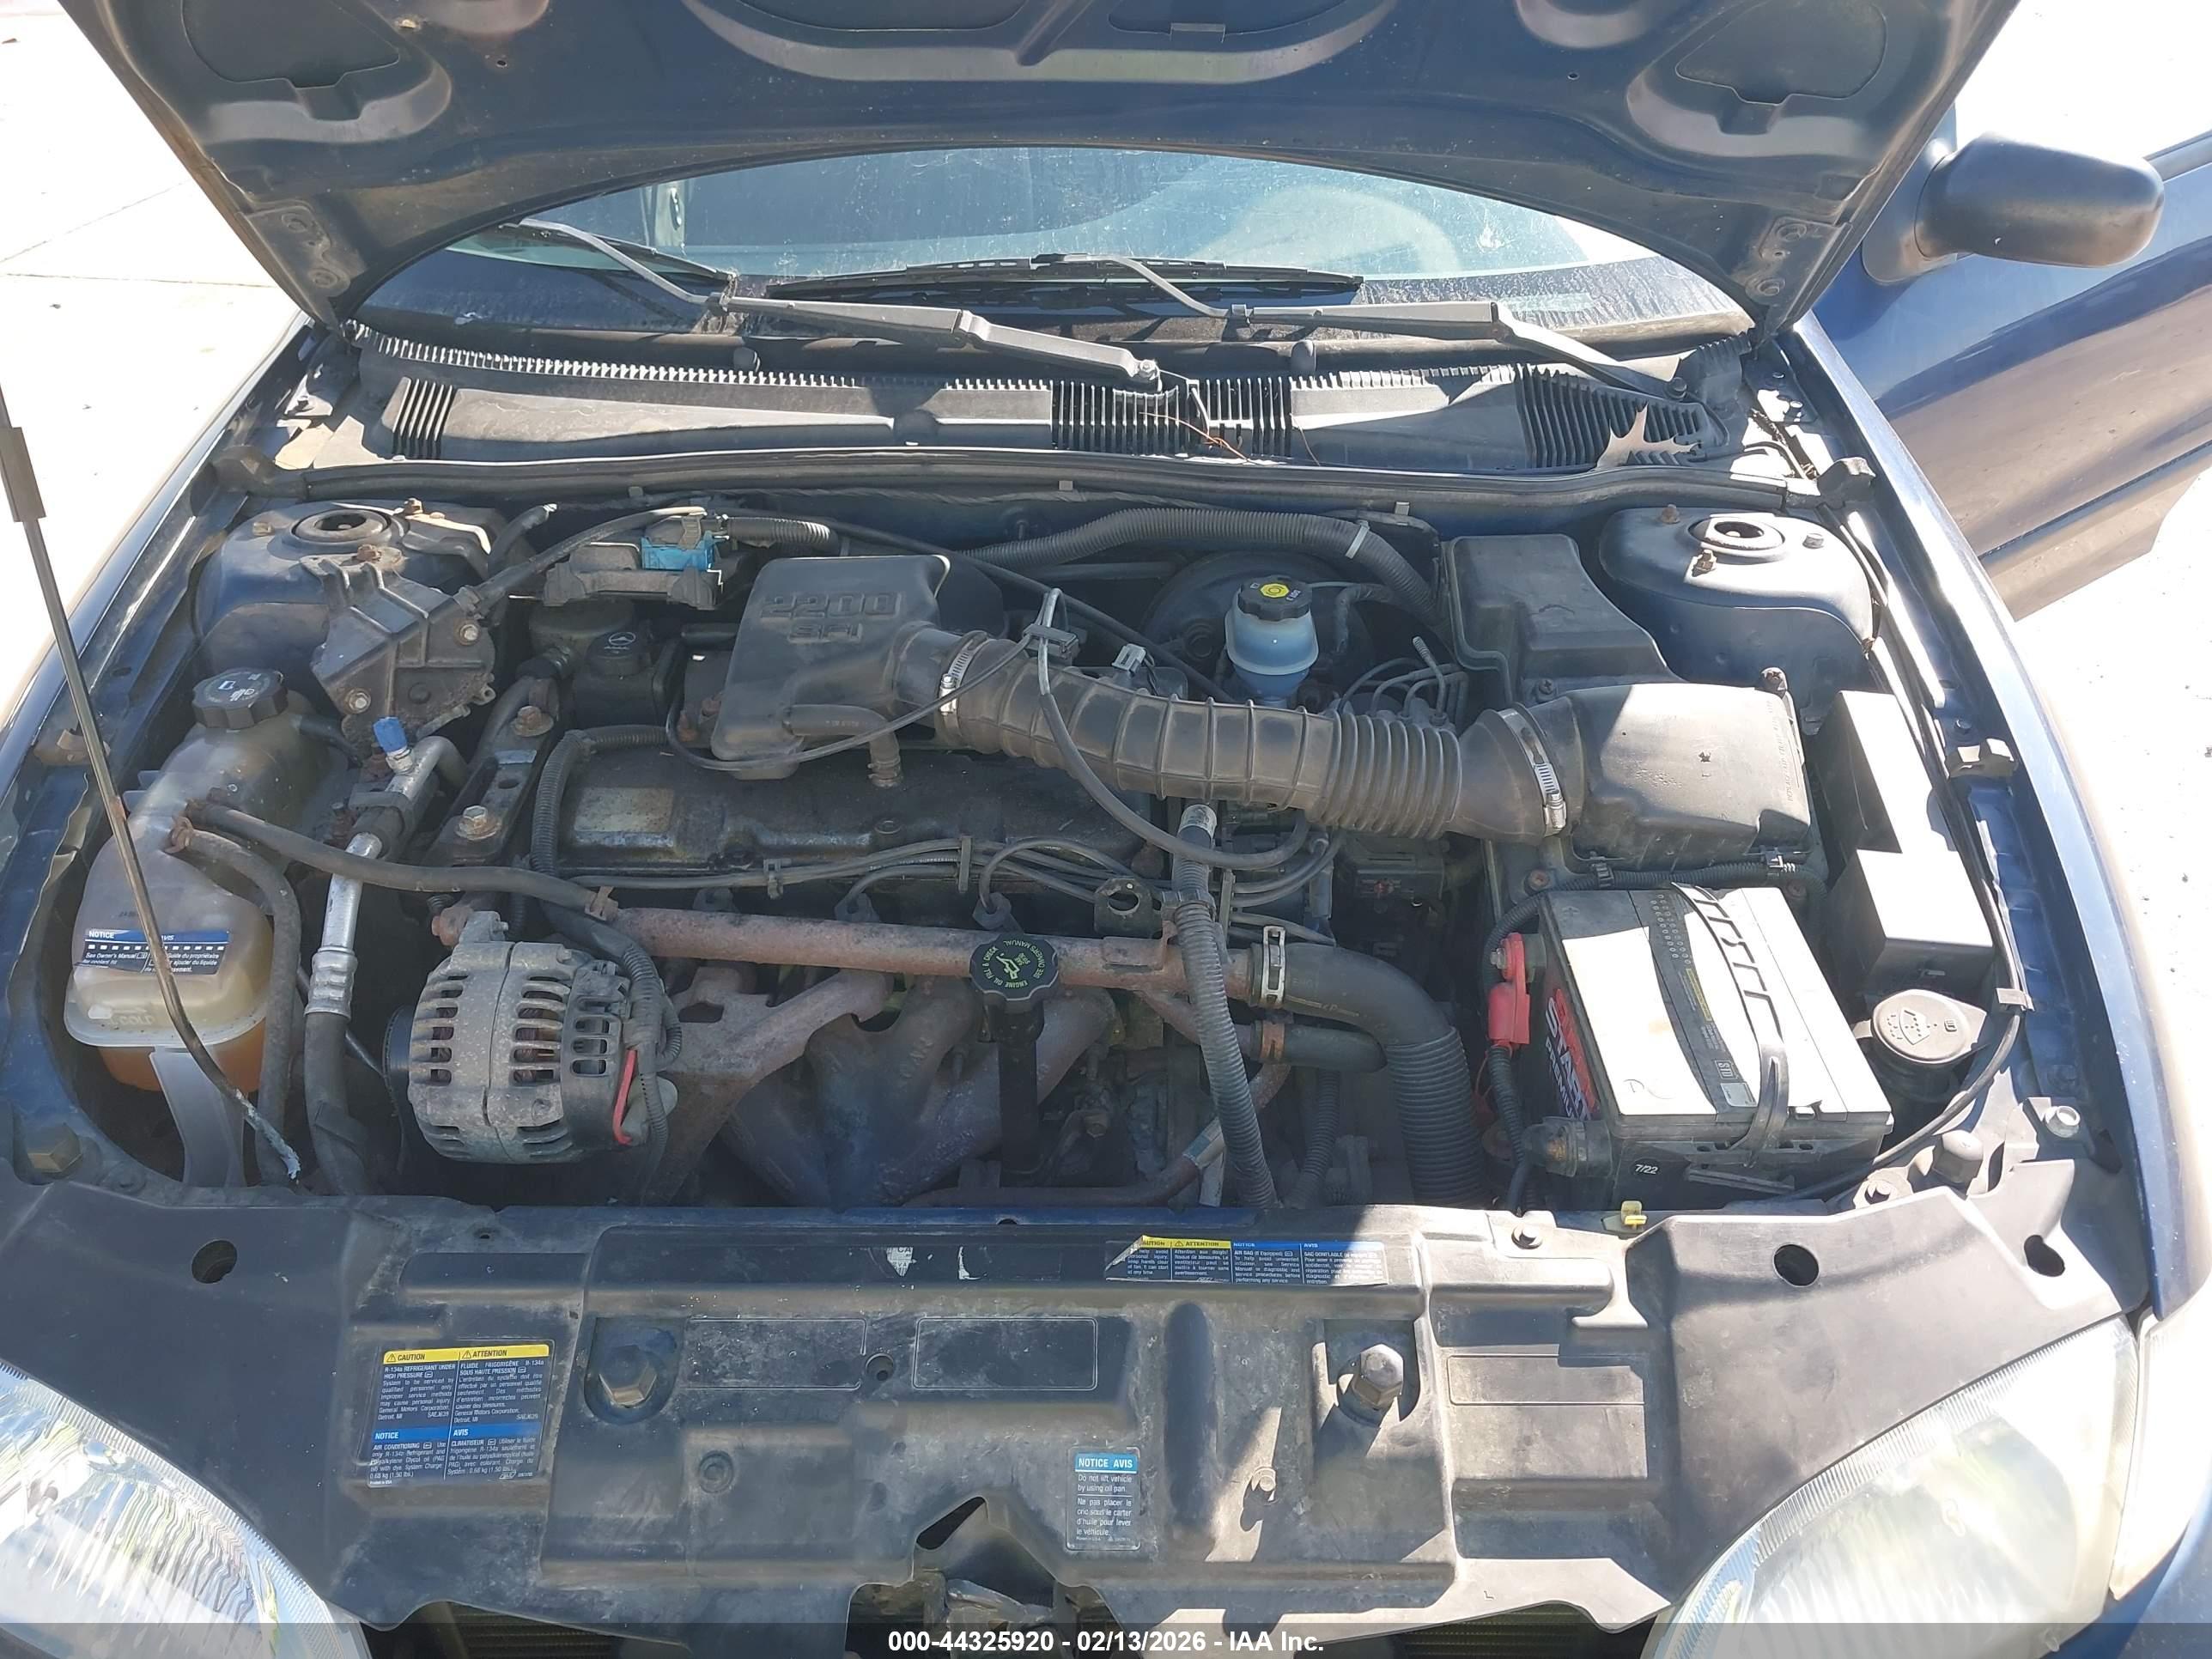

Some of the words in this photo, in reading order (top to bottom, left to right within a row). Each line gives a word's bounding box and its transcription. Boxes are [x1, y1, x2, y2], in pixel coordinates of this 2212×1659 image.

[759, 591, 908, 621] 2200
[88, 930, 116, 939] NOTICE
[983, 945, 999, 961] CHECK
[983, 968, 994, 979] FILL
[994, 977, 1003, 986] OIL
[1005, 980, 1029, 988] ENGINE
[1546, 1036, 1575, 1119] PREMIU
[1635, 1164, 1659, 1174] 7/22
[472, 1349, 507, 1358] ATTENTION
[374, 1431, 399, 1440] NOTICE
[453, 1428, 469, 1437] AVIS
[1078, 1457, 1109, 1468] NOTICE
[1113, 1458, 1133, 1468] AVIS
[1089, 1474, 1099, 1482] not
[1100, 1474, 1109, 1482] lift
[1110, 1474, 1133, 1483] vehicle
[1078, 1483, 1085, 1492] by
[1086, 1484, 1103, 1492] using
[1104, 1484, 1113, 1492] oil
[1077, 1497, 1086, 1505] Ne
[1089, 1498, 1101, 1507] pas
[1103, 1498, 1123, 1507] placer
[1105, 1508, 1112, 1516] le
[1113, 1509, 1132, 1517] carter
[1076, 1517, 1097, 1526] d'huile
[1099, 1518, 1115, 1528] pour
[1115, 1518, 1132, 1527] lever
